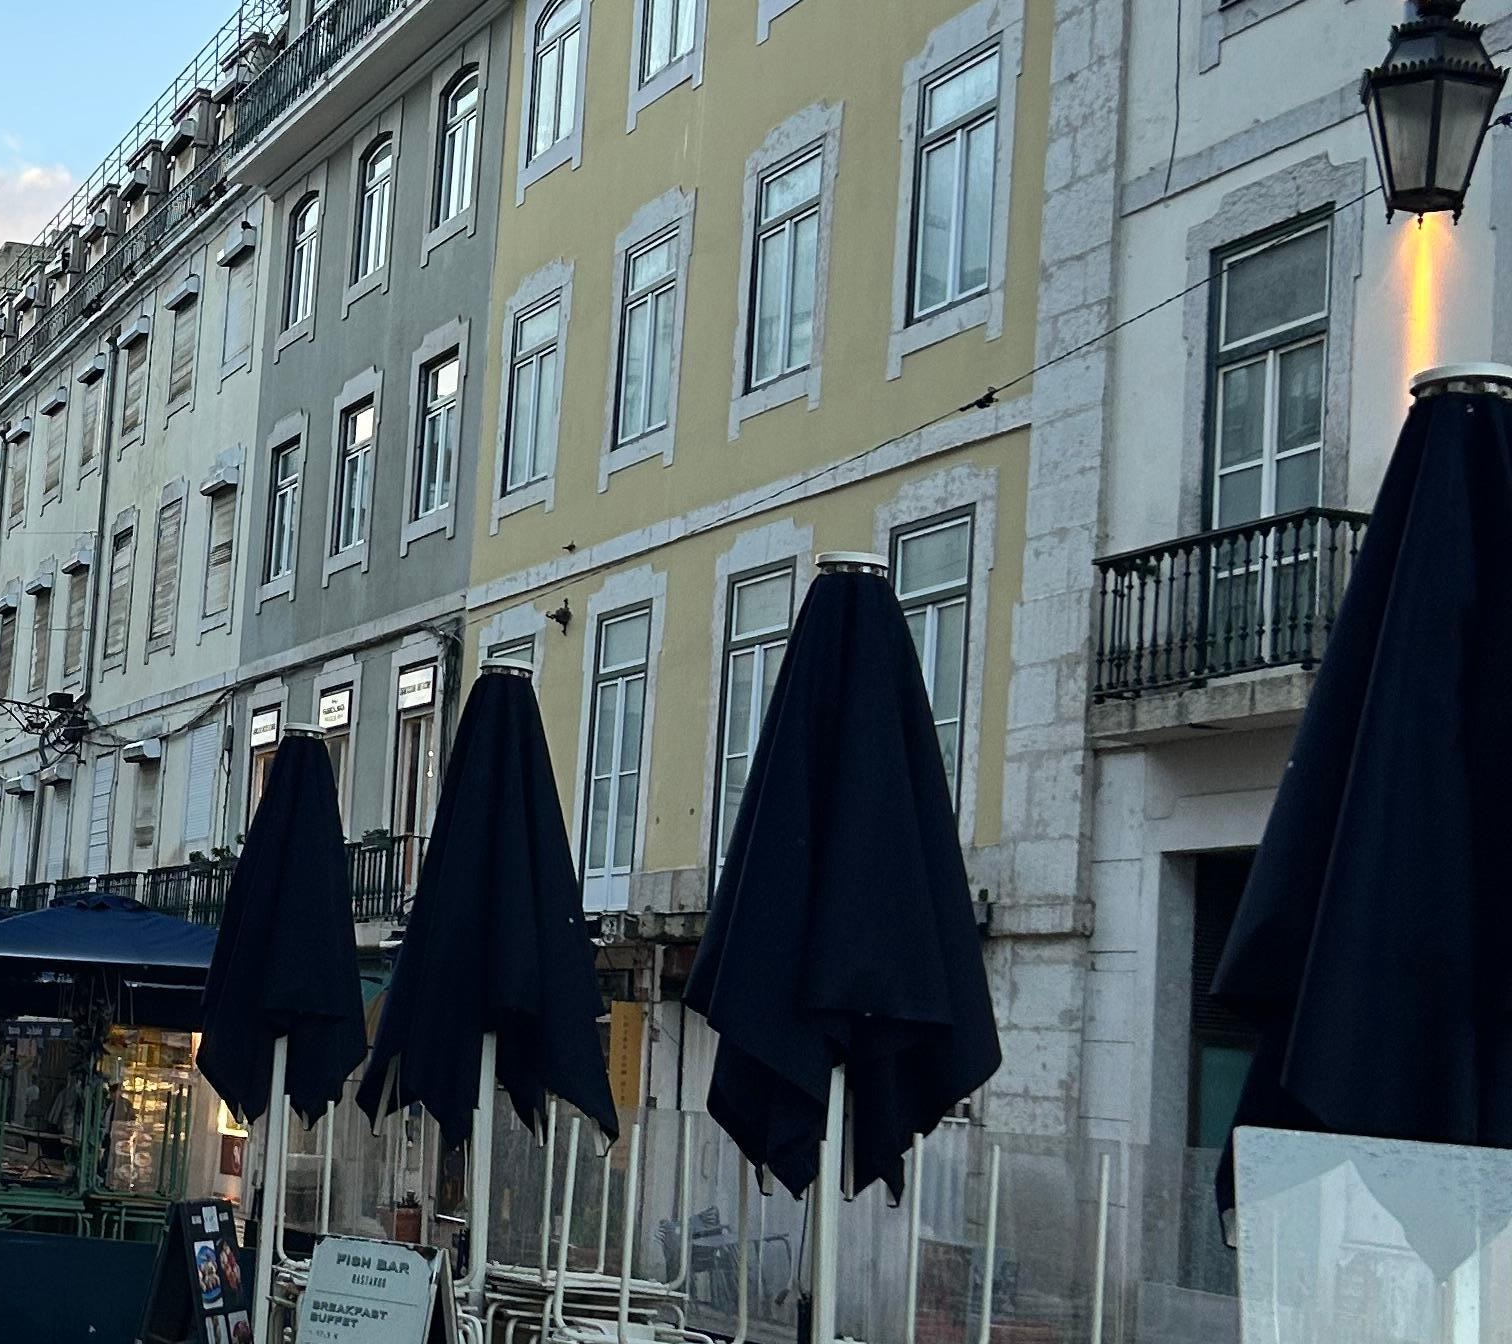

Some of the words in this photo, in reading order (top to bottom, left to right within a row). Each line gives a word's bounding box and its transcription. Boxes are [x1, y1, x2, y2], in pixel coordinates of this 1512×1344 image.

[337, 1253, 371, 1269] FISH
[377, 1259, 410, 1274] BAR
[310, 1312, 359, 1328] BUFFET
[312, 1301, 388, 1320] BREAKFAST
